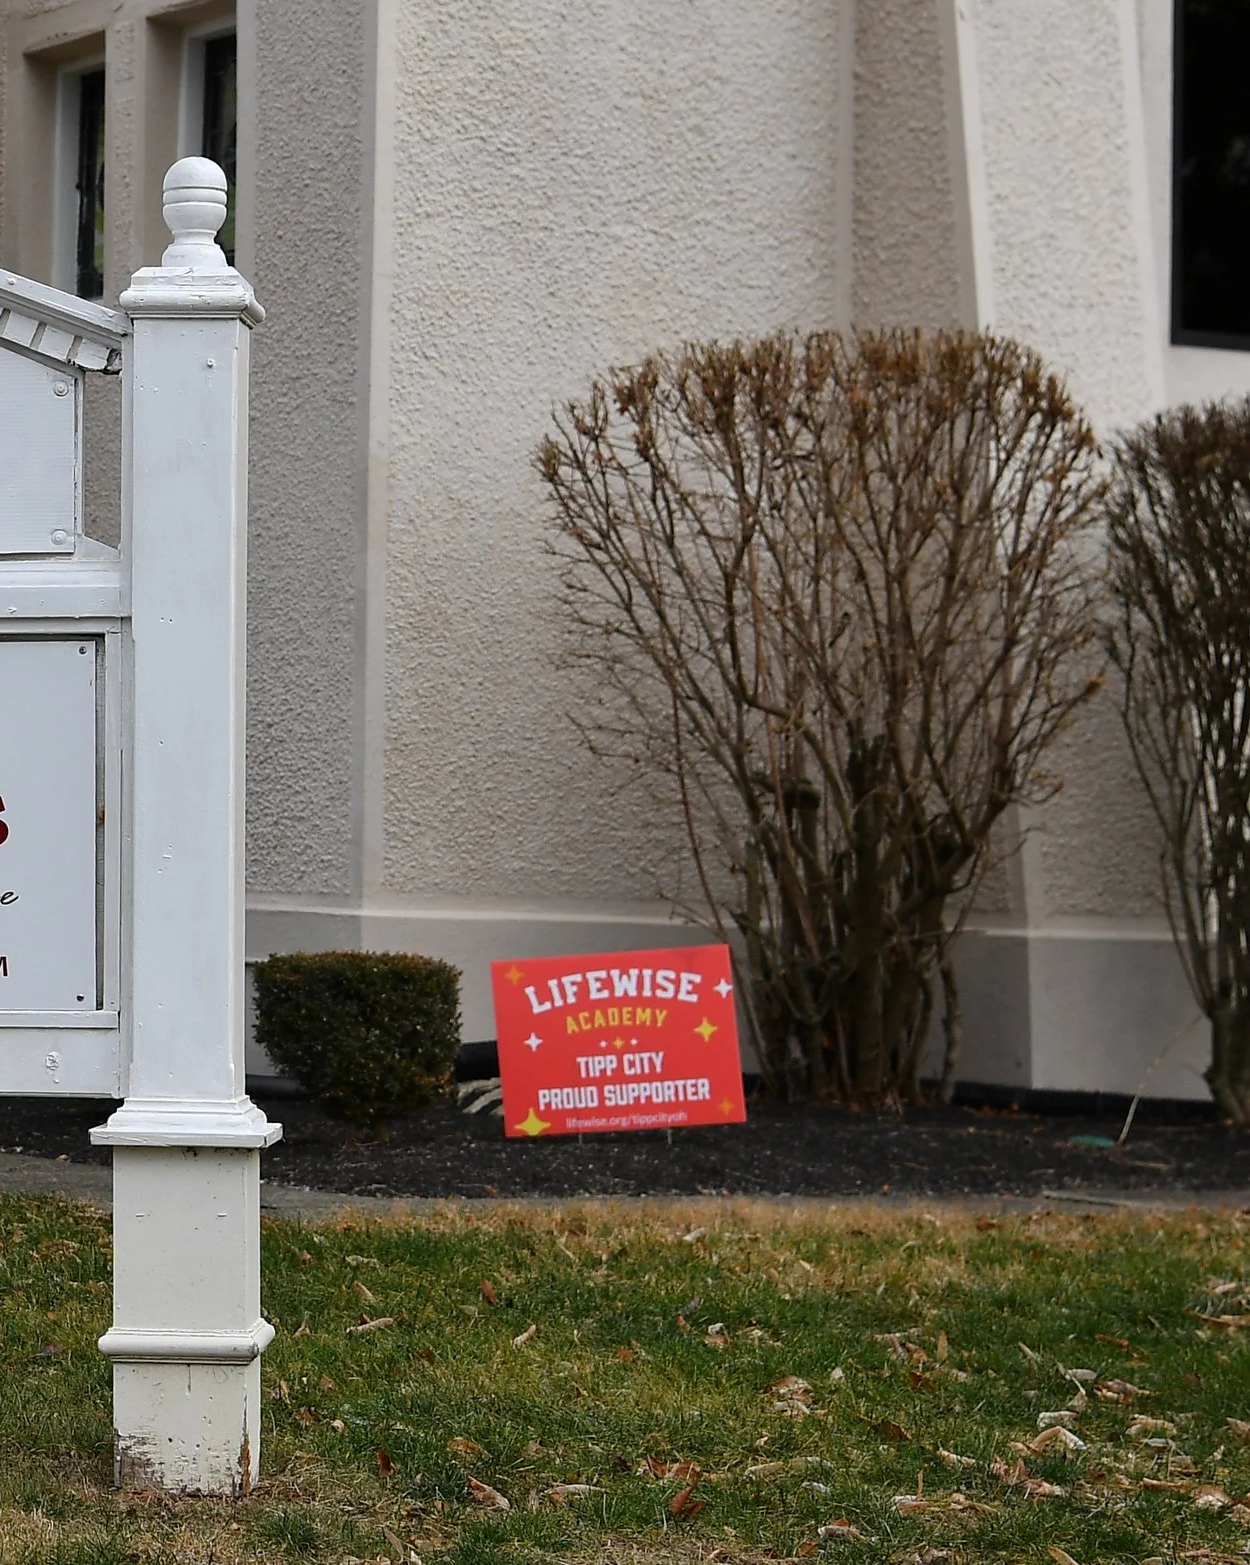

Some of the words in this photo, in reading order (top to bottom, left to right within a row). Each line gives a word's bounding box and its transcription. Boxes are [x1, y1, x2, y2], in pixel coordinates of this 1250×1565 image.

[524, 968, 702, 1015] LIFEWISE
[565, 1007, 667, 1034] ACADEMY
[576, 1053, 618, 1079] TIPP
[623, 1051, 665, 1076] CITY
[538, 1086, 599, 1111] PROUD
[603, 1078, 711, 1106] SUPPORTER
